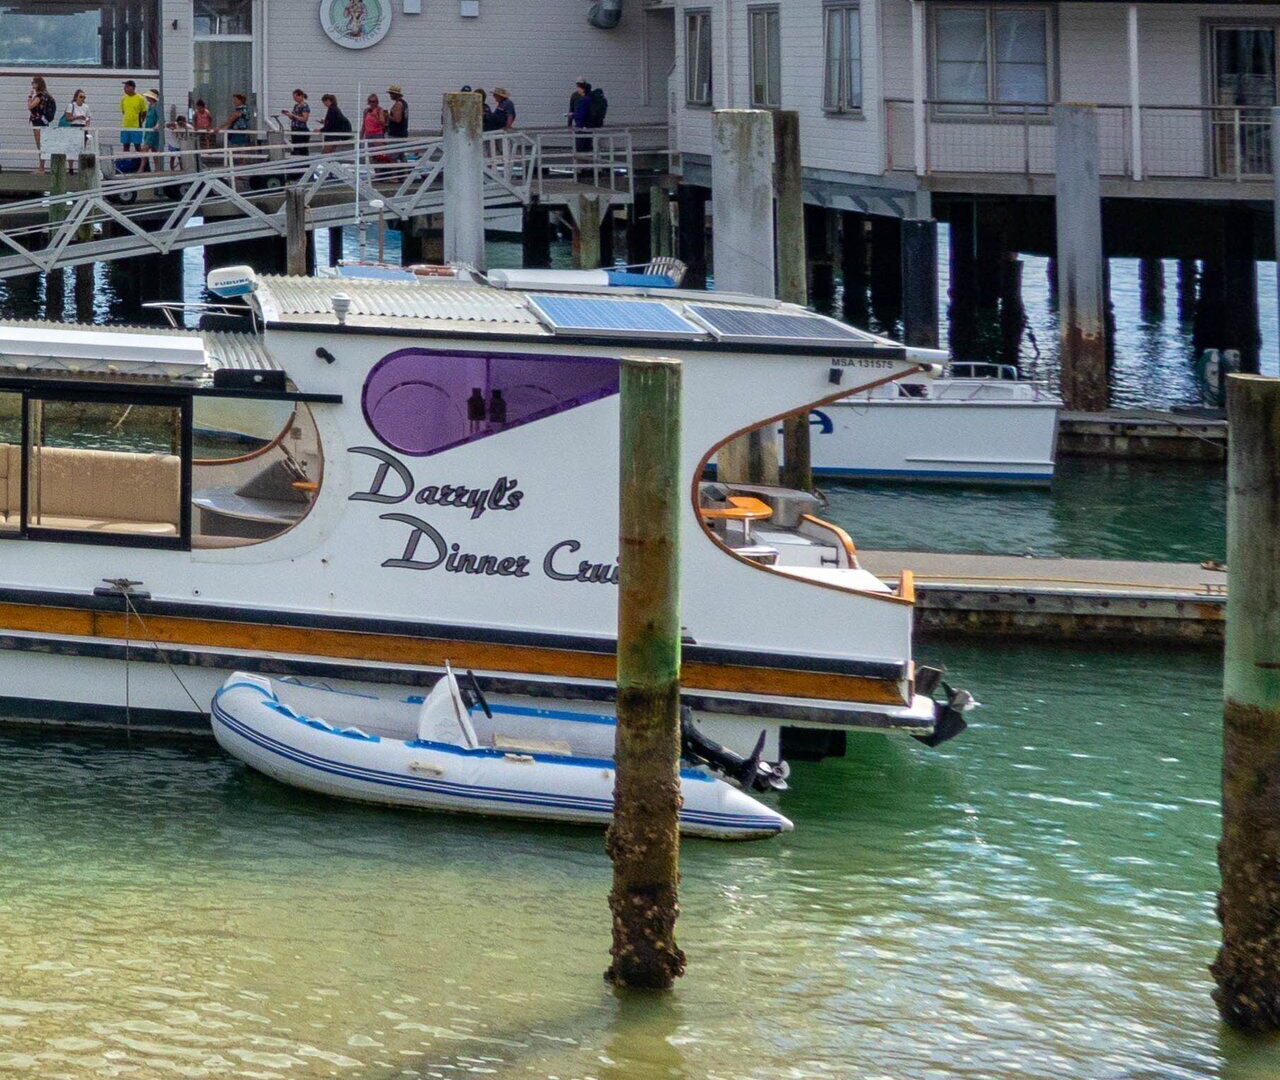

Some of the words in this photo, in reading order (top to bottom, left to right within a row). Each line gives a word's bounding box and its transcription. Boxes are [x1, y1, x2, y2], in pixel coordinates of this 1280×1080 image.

[831, 358, 855, 367] MSA
[347, 446, 525, 520] Darryl's
[378, 512, 530, 578] Dinner
[543, 539, 620, 585] Crui
